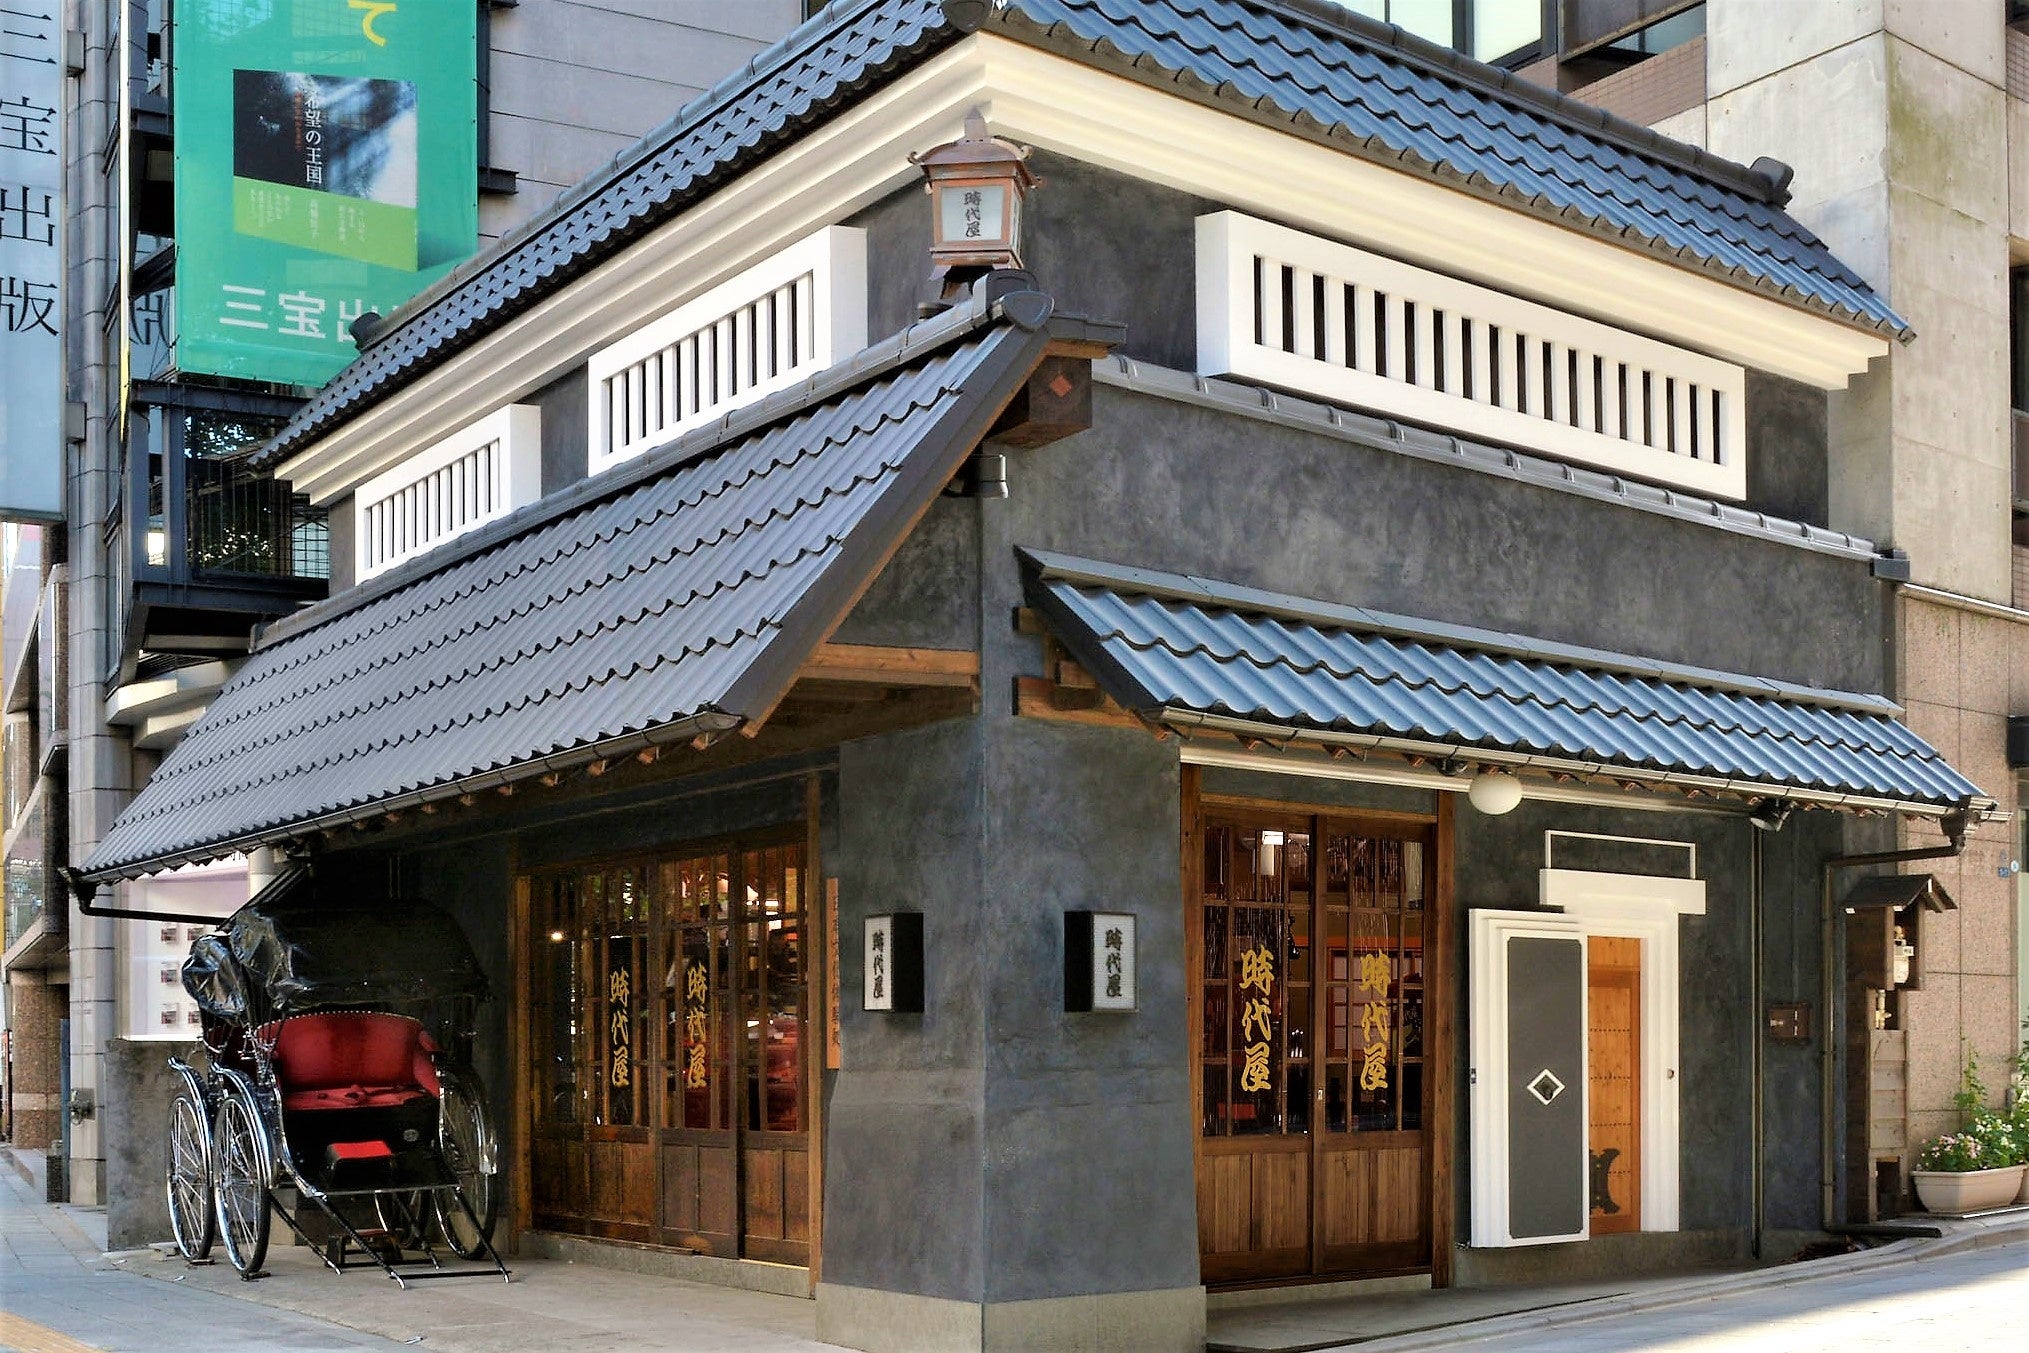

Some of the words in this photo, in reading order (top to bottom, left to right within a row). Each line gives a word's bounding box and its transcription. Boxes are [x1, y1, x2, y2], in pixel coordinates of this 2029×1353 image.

[0, 9, 58, 337] 三宝出版
[964, 190, 982, 237] 時代屋
[687, 961, 708, 1089] 時代屋
[1105, 927, 1123, 998] 時代屋
[1240, 945, 1274, 1092] 時代屋
[1359, 949, 1391, 1091] 時代屋
[610, 966, 630, 1088] 時代屋
